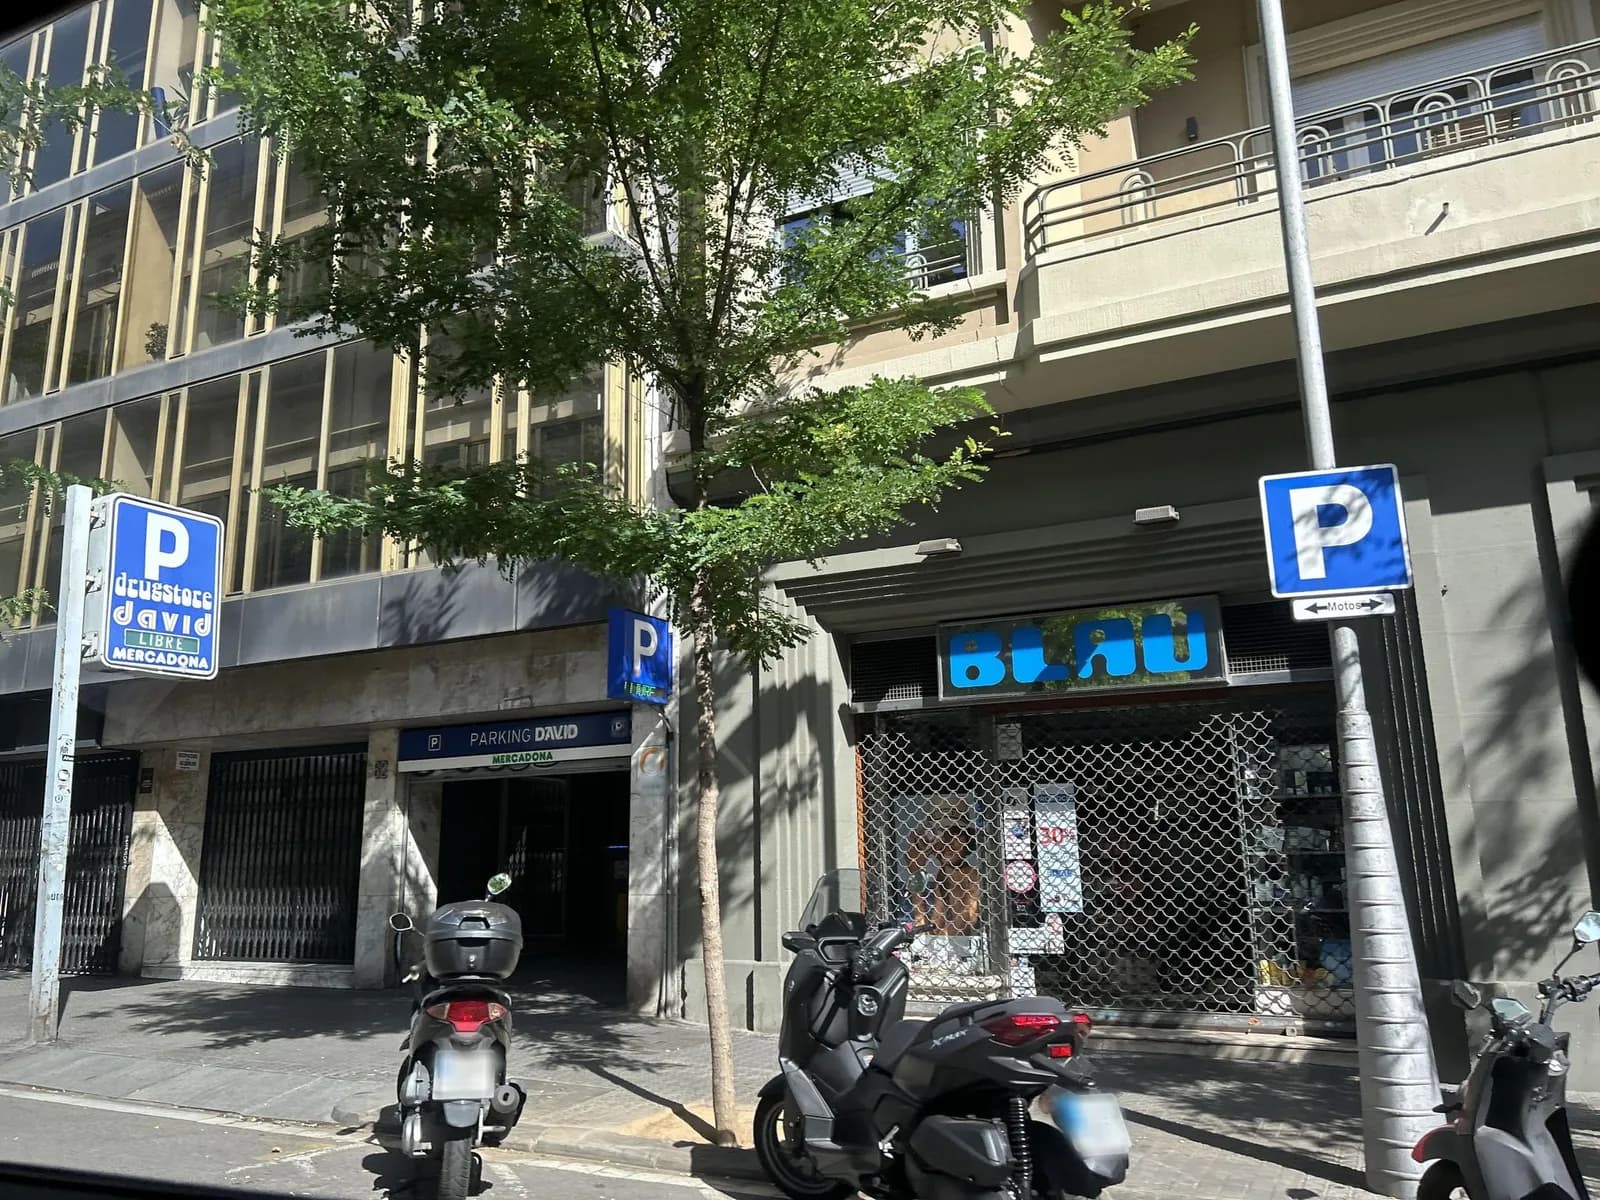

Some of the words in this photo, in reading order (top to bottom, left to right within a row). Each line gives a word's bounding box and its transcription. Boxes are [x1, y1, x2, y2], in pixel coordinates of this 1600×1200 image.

[144, 511, 190, 581] P
[1289, 484, 1374, 580] P
[114, 571, 213, 611] drugstore
[1327, 601, 1362, 612] Motos
[113, 600, 212, 637] david
[112, 647, 209, 669] MERCADONA
[138, 632, 184, 651] LIBRE
[633, 618, 658, 677] P
[949, 611, 1209, 689] BLAU
[431, 737, 439, 749] P
[470, 728, 531, 747] PARKING
[534, 724, 579, 742] DAVID
[492, 751, 554, 764] MERCADONA
